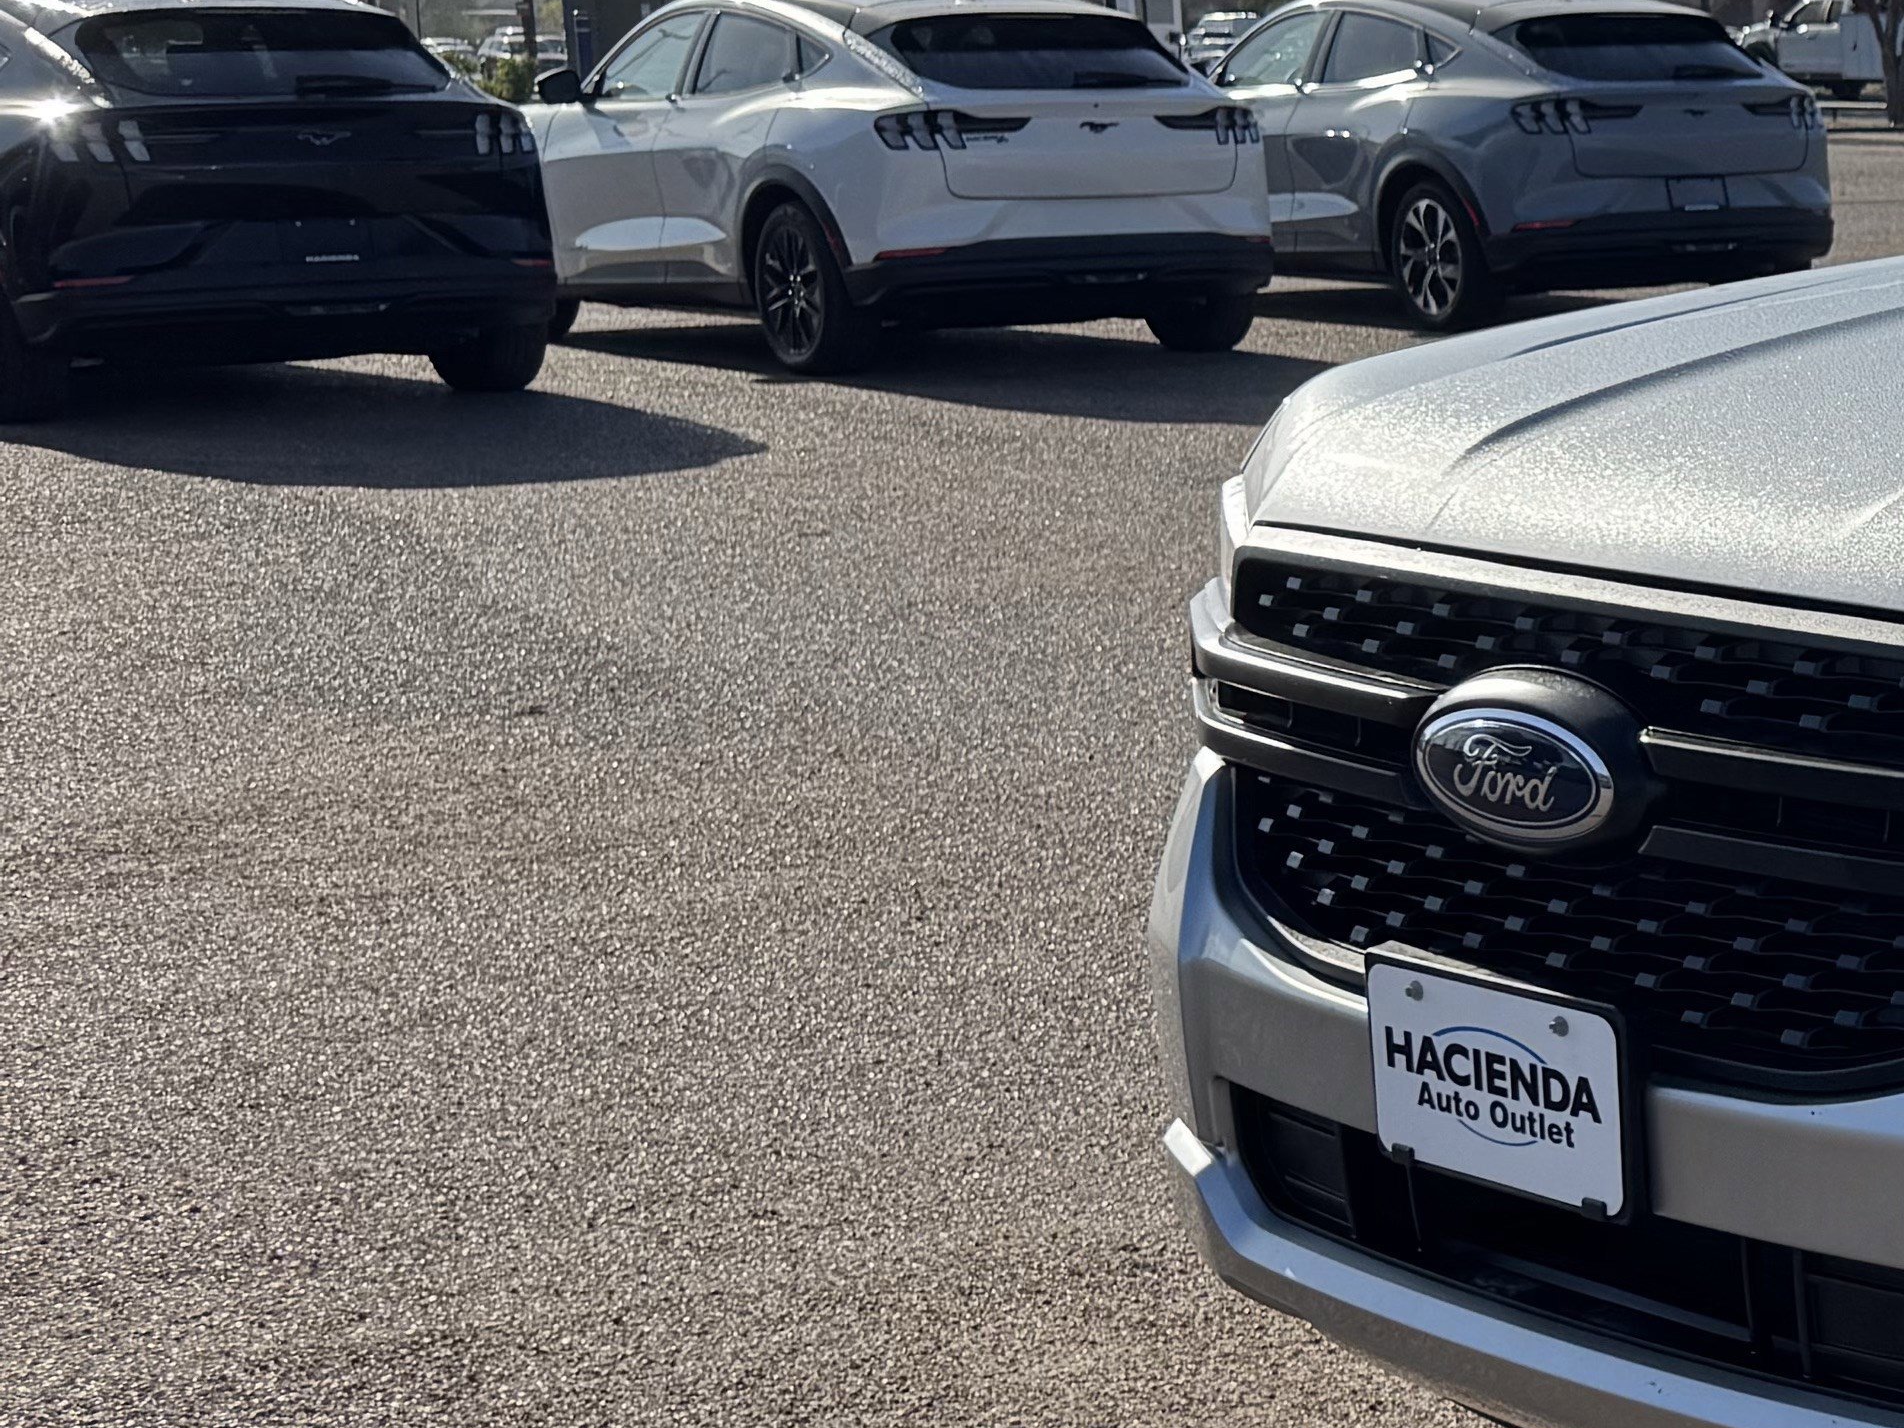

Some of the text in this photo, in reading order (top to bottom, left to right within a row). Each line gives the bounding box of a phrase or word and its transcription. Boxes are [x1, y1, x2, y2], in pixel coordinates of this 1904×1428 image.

[1453, 733, 1558, 812] Ford
[1384, 1025, 1602, 1124] HACIENDA
[1417, 1081, 1575, 1149] Auto Outlet
